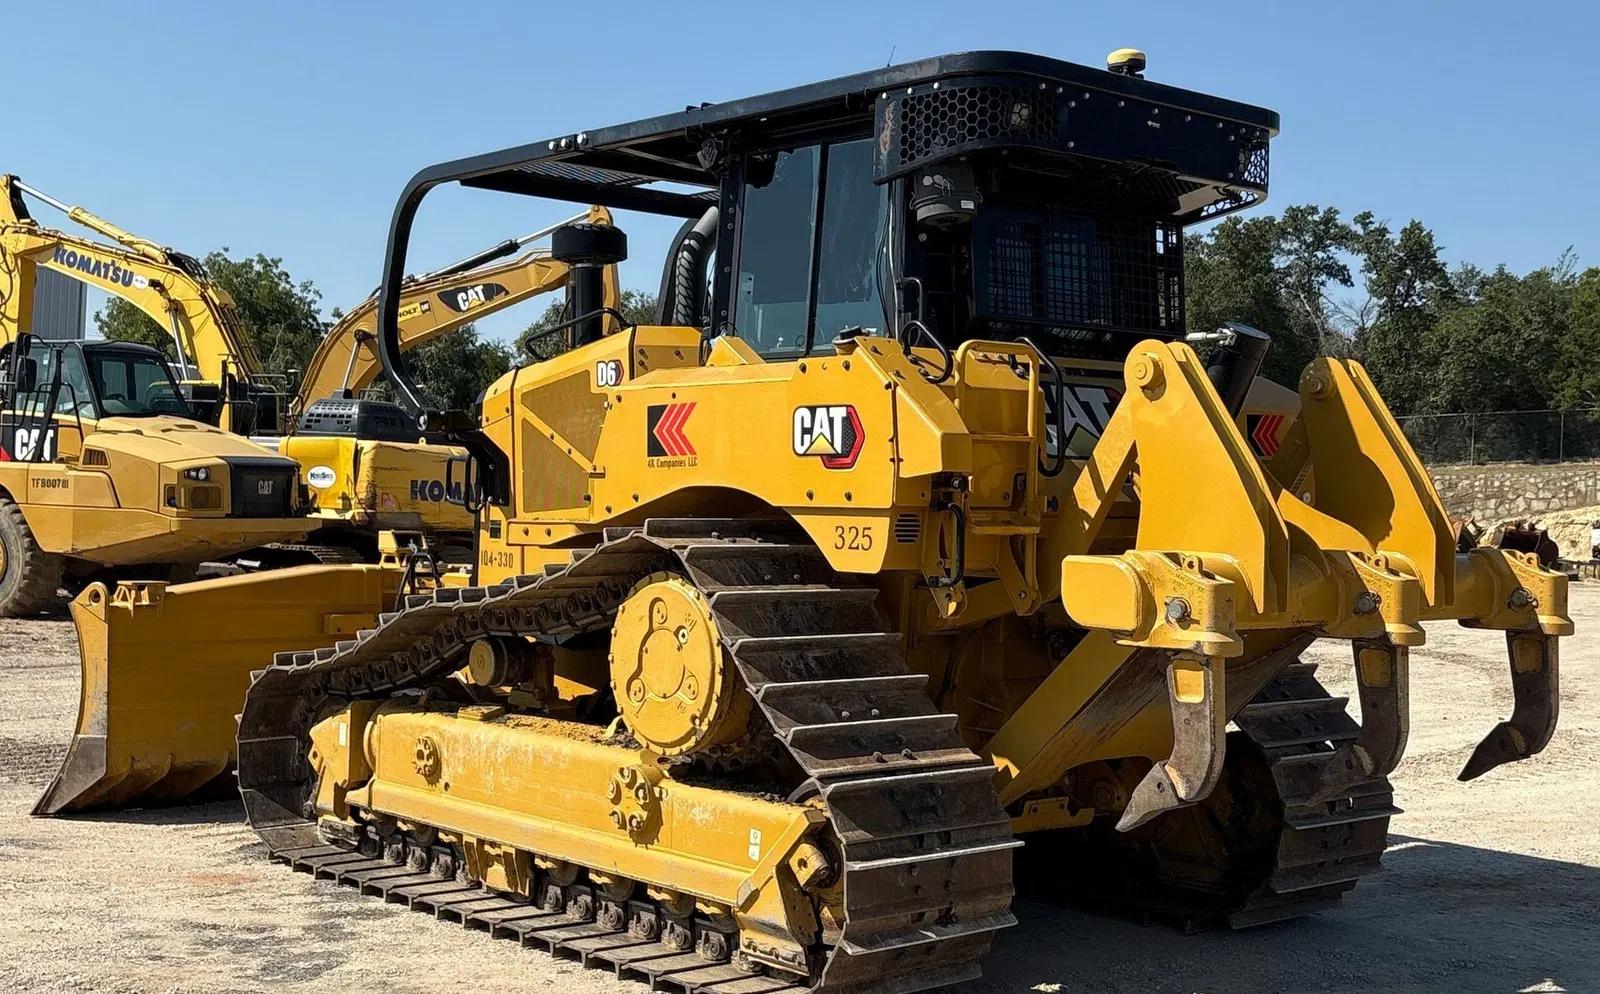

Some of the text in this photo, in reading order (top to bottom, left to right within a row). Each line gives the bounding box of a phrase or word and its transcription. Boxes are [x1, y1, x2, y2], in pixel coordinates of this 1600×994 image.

[54, 246, 134, 287] KOMATSU
[457, 284, 484, 311] CAT
[597, 361, 615, 386] D6
[793, 406, 847, 455] CAT
[647, 456, 698, 470] 4K Companies LLC
[258, 480, 273, 494] CAT
[834, 525, 873, 551] 325
